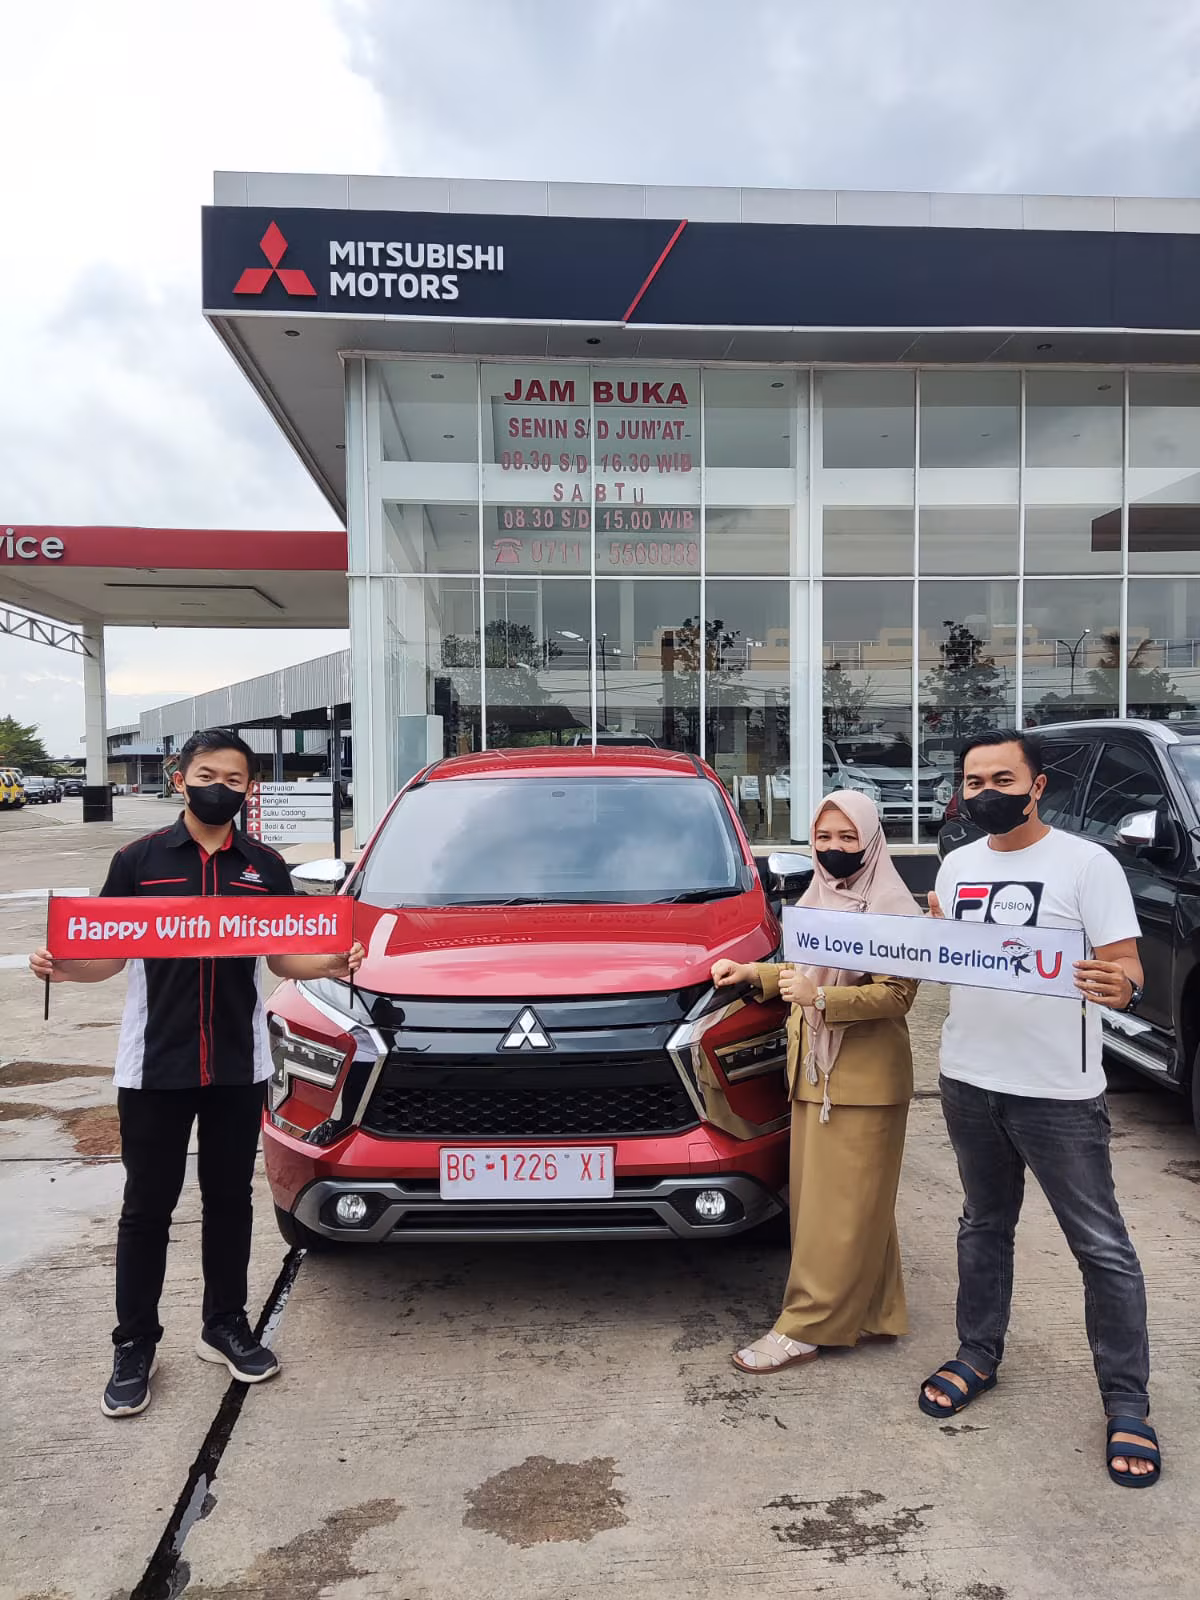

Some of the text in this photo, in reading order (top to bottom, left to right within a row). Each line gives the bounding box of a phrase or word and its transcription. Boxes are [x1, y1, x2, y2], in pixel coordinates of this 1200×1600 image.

[329, 240, 504, 271] MITSUBISHI
[330, 271, 459, 300] MOTORS
[504, 378, 689, 405] JAM BUKA
[508, 417, 568, 439] SENIN
[616, 420, 685, 440] JUM'AT
[502, 450, 692, 474] 08.30 S/D 16.30 WIB
[561, 508, 590, 530] S/D
[658, 510, 694, 530] WIB
[0, 527, 64, 559] ice
[262, 784, 295, 792] Penjualan
[262, 797, 289, 805] Bengkel
[281, 809, 306, 818] Cadang
[993, 901, 1033, 912] FUSION
[67, 913, 337, 940] Happy With Mitsubishi
[796, 931, 820, 950] We
[825, 934, 864, 954] Love
[869, 938, 932, 963] Lautan
[938, 946, 1009, 971] Berlian
[447, 1152, 606, 1182] BG 1226 XI
